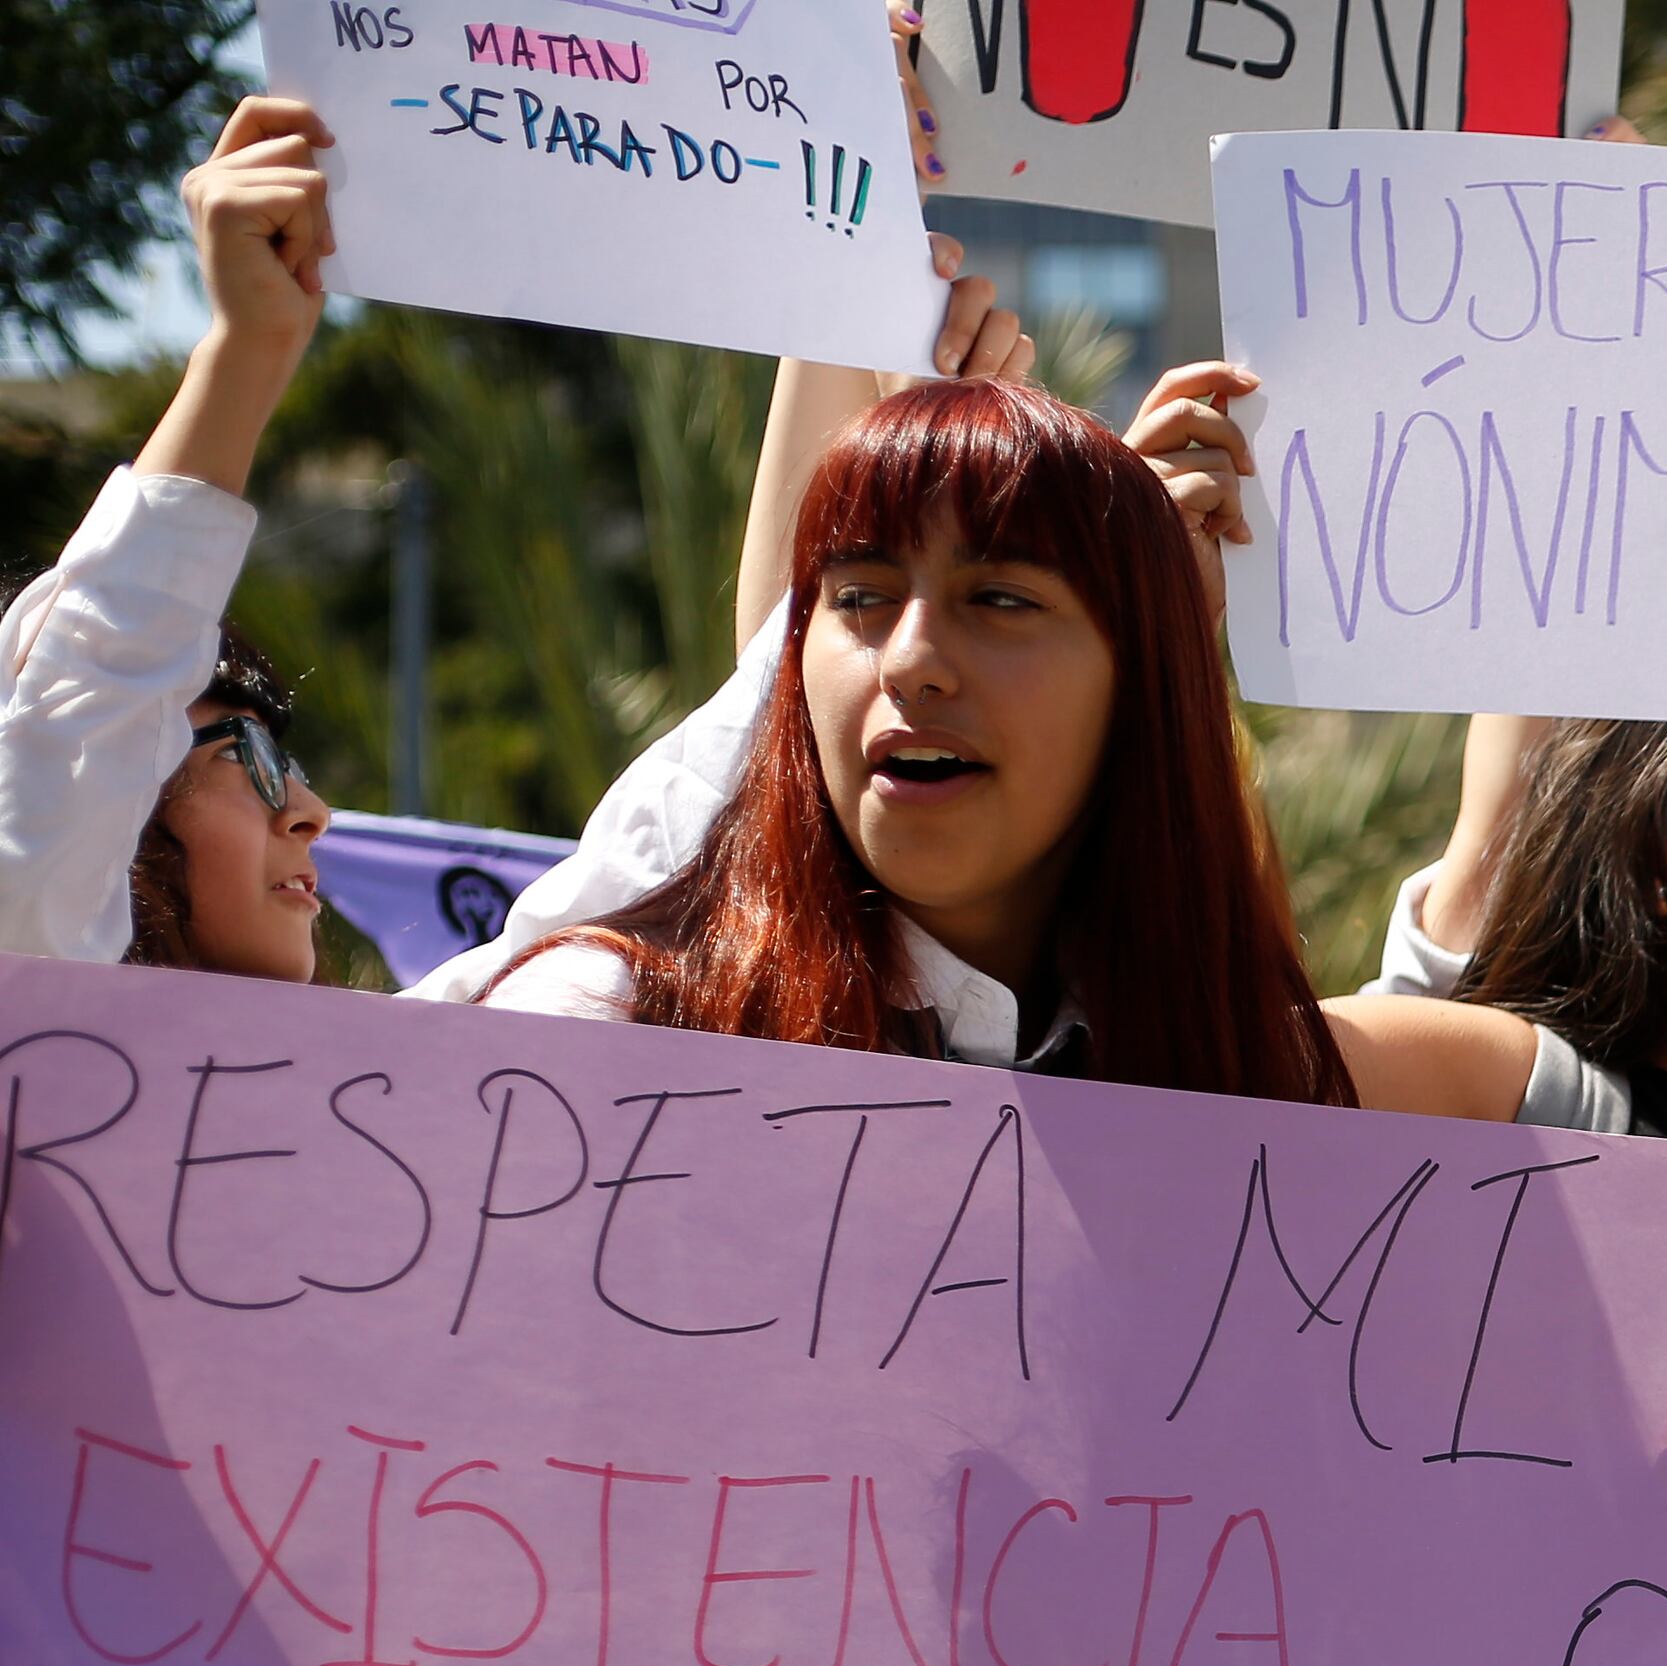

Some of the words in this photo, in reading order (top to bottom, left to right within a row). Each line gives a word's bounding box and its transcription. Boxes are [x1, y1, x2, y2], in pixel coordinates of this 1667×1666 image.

[330, 1, 415, 52] NOS
[464, 23, 642, 84] MATAN
[715, 59, 808, 124] POR
[0, 1029, 1032, 1382] RESPETA
[1164, 1142, 1601, 1469] MI
